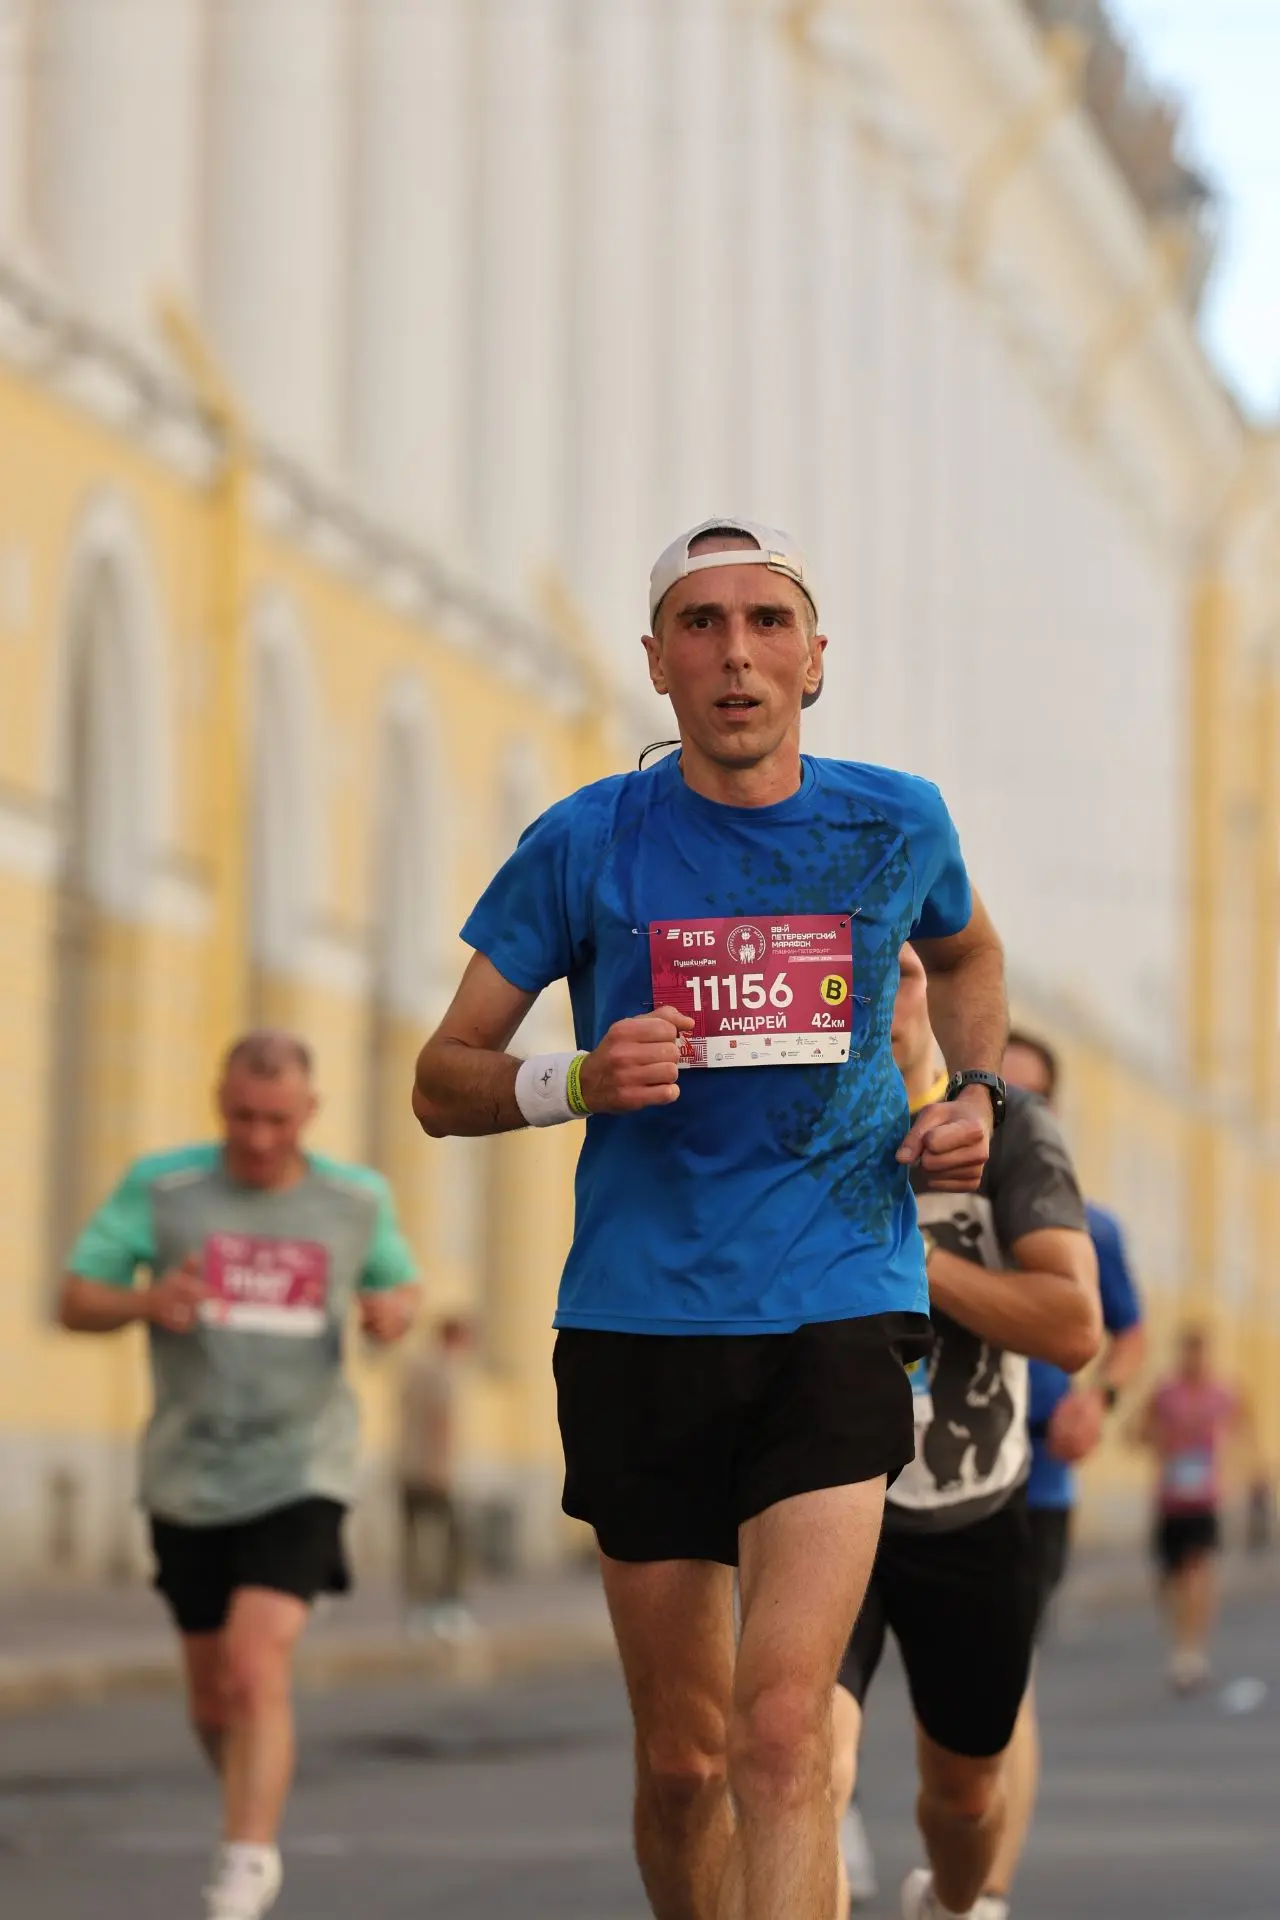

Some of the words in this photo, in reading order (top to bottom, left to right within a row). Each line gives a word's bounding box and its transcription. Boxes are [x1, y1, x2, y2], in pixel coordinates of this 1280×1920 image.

[682, 930, 715, 947] ВТБ
[771, 931, 837, 941] ПЕТЕРБУРГСКИЙ
[771, 940, 811, 949] МАРАФОН
[686, 972, 794, 1012] 11156
[719, 1011, 787, 1032] АНДРЕЙ
